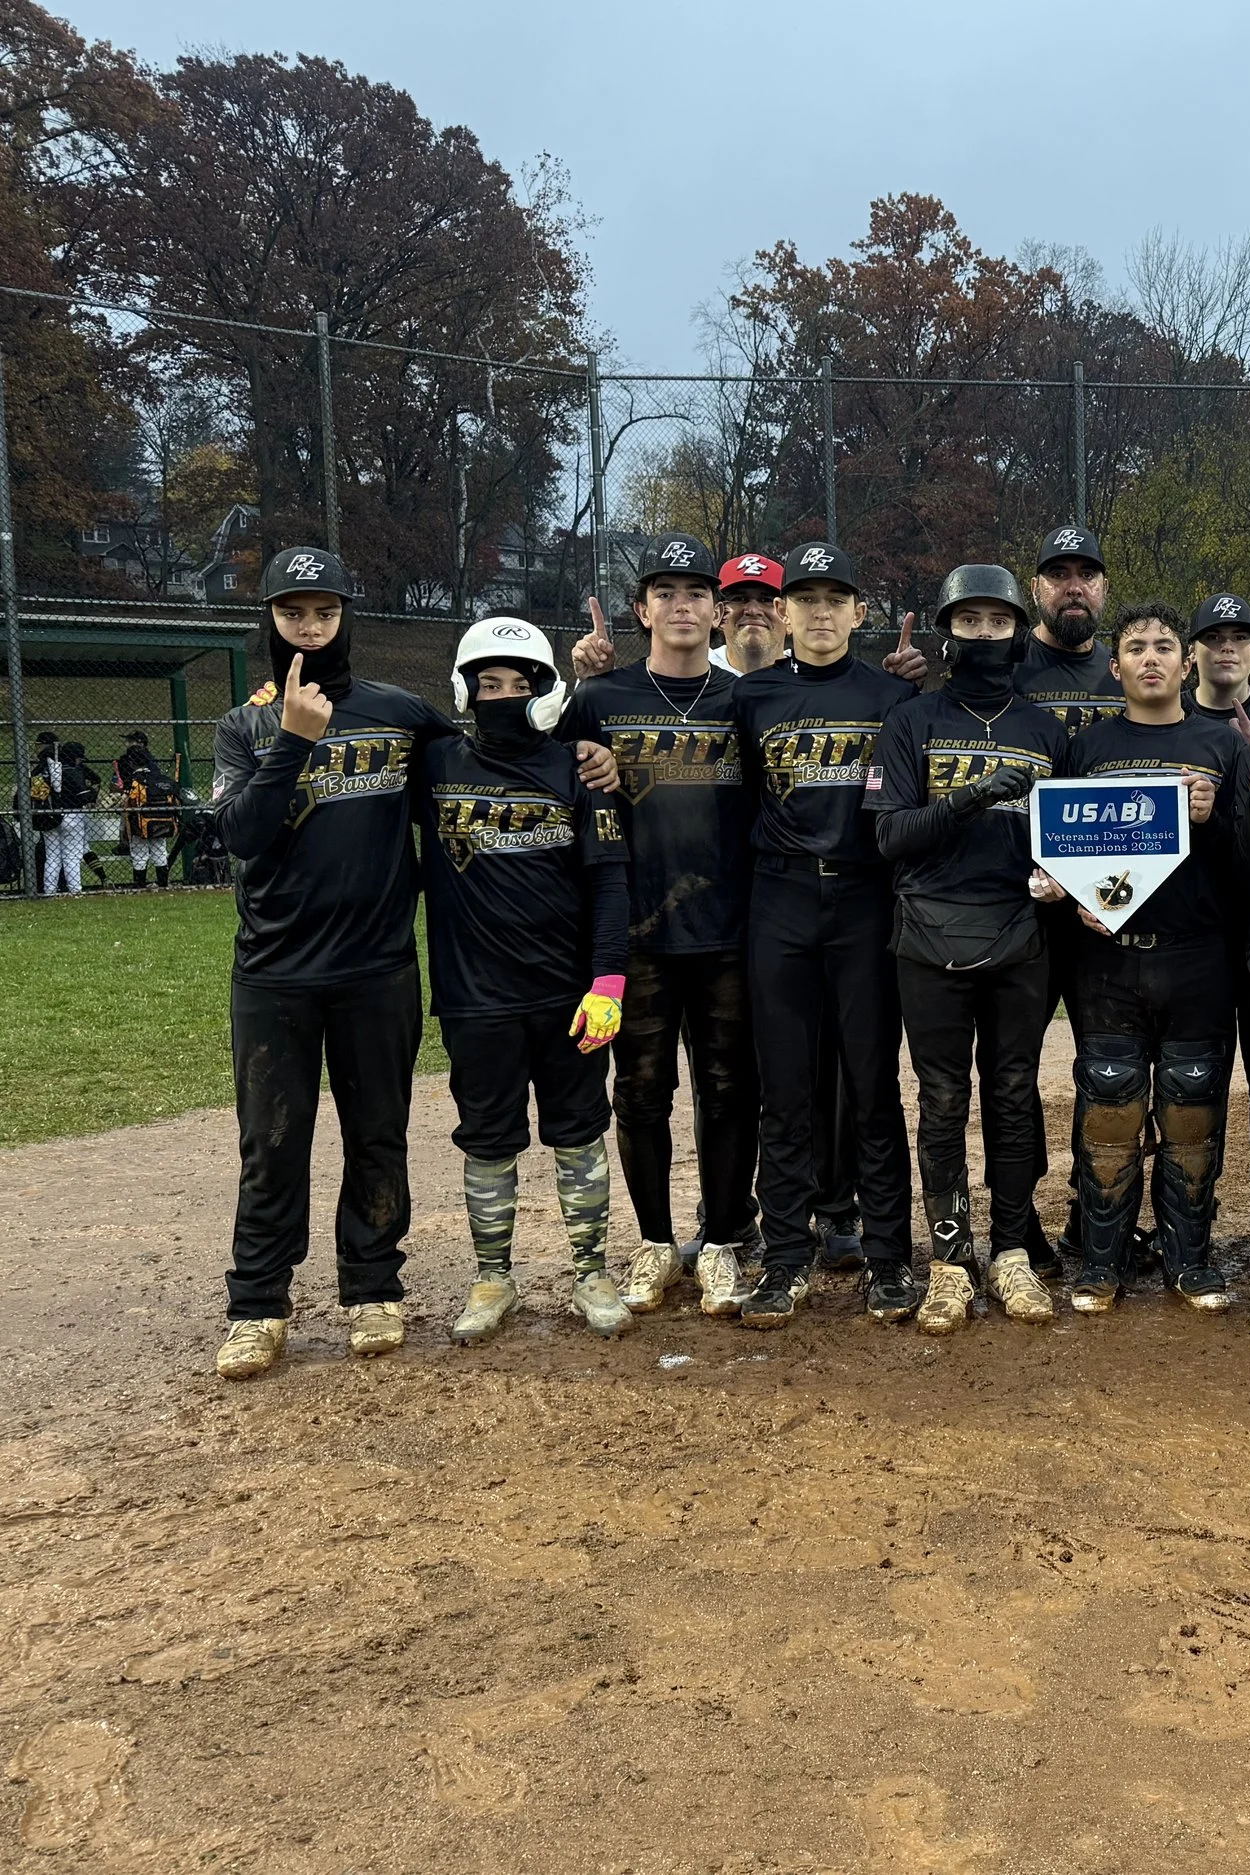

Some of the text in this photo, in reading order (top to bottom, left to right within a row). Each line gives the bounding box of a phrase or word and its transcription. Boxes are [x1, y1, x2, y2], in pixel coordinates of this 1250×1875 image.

[1053, 529, 1085, 550] RE
[661, 541, 696, 567] RE
[800, 547, 834, 572] RE
[286, 554, 325, 580] RE
[737, 555, 768, 576] RE
[1213, 597, 1242, 618] RE
[607, 715, 683, 726] ROCKLAND
[927, 739, 997, 750] ROCKLAND
[800, 759, 870, 783] Baseba
[436, 783, 505, 794] ROCKLAND
[1062, 802, 1154, 823] USABL
[594, 809, 622, 841] RE
[476, 823, 573, 850] Baseball
[1045, 830, 1175, 842] Veterans Day Classic
[1058, 841, 1162, 854] Champions 2025
